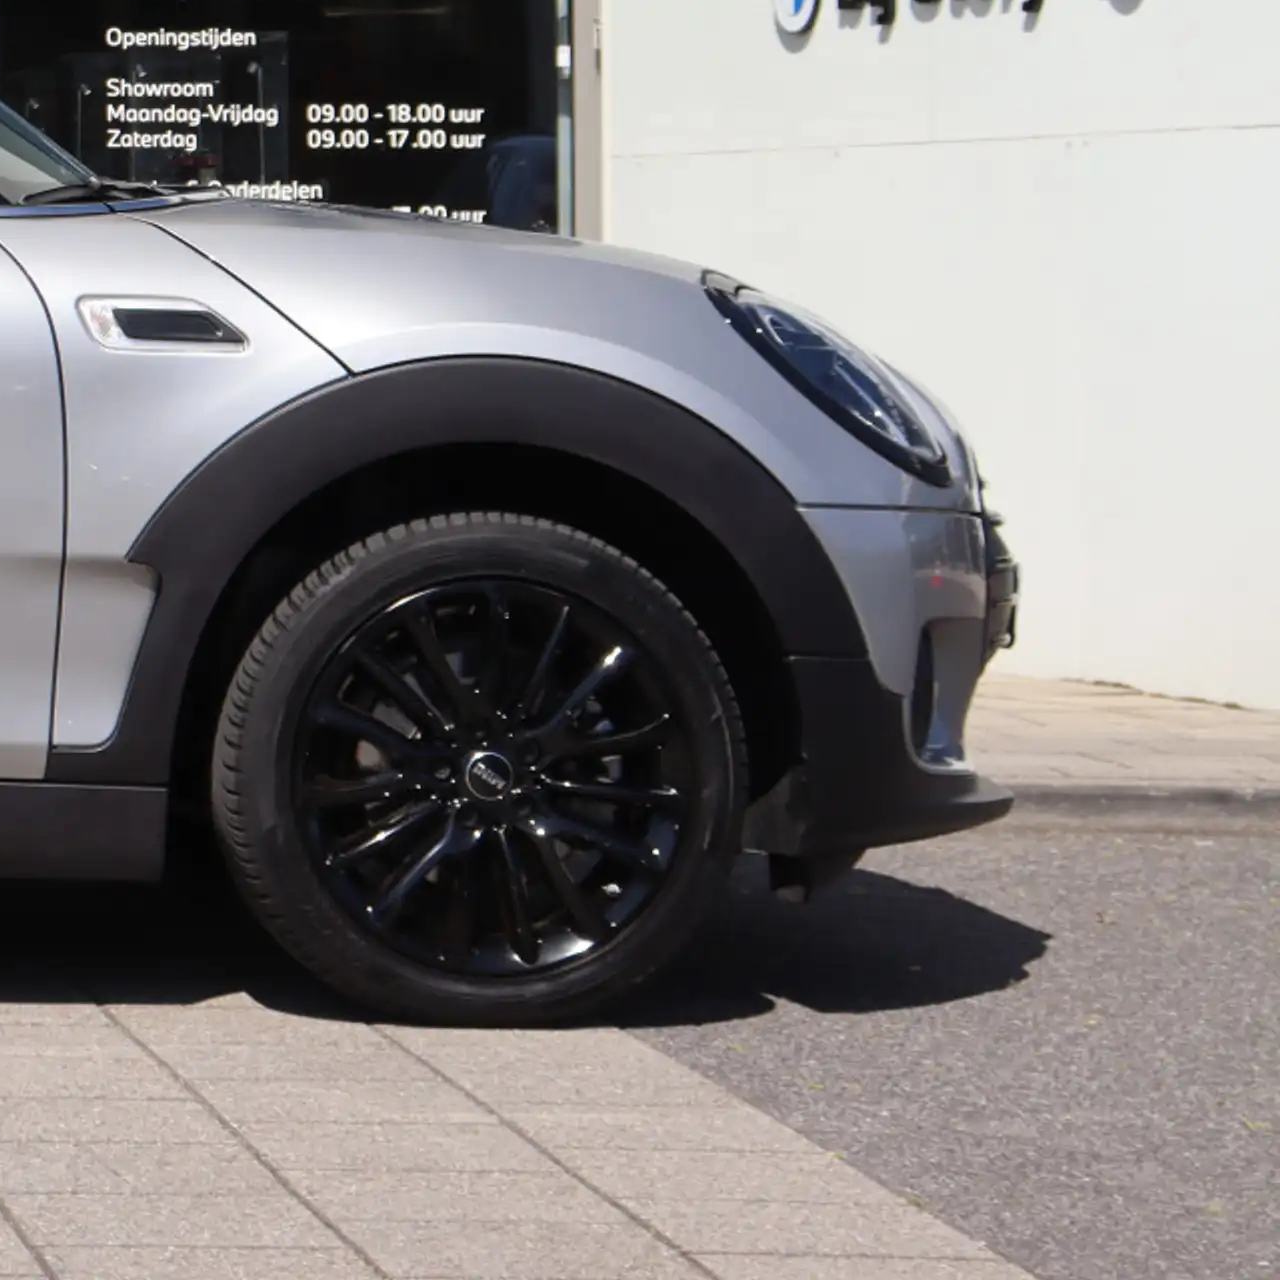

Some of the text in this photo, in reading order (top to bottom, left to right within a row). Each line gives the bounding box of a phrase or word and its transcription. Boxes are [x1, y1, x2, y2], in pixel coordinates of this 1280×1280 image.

[106, 28, 257, 50] Openingstijden
[106, 78, 214, 98] Showroom
[106, 104, 279, 126] Maandag-Vrijdag
[307, 103, 369, 123] 09.00
[387, 103, 446, 123] 18.00
[450, 108, 485, 123] uur
[106, 129, 198, 151] Zaterdag
[307, 129, 369, 149] 09.00
[450, 134, 486, 149] uur
